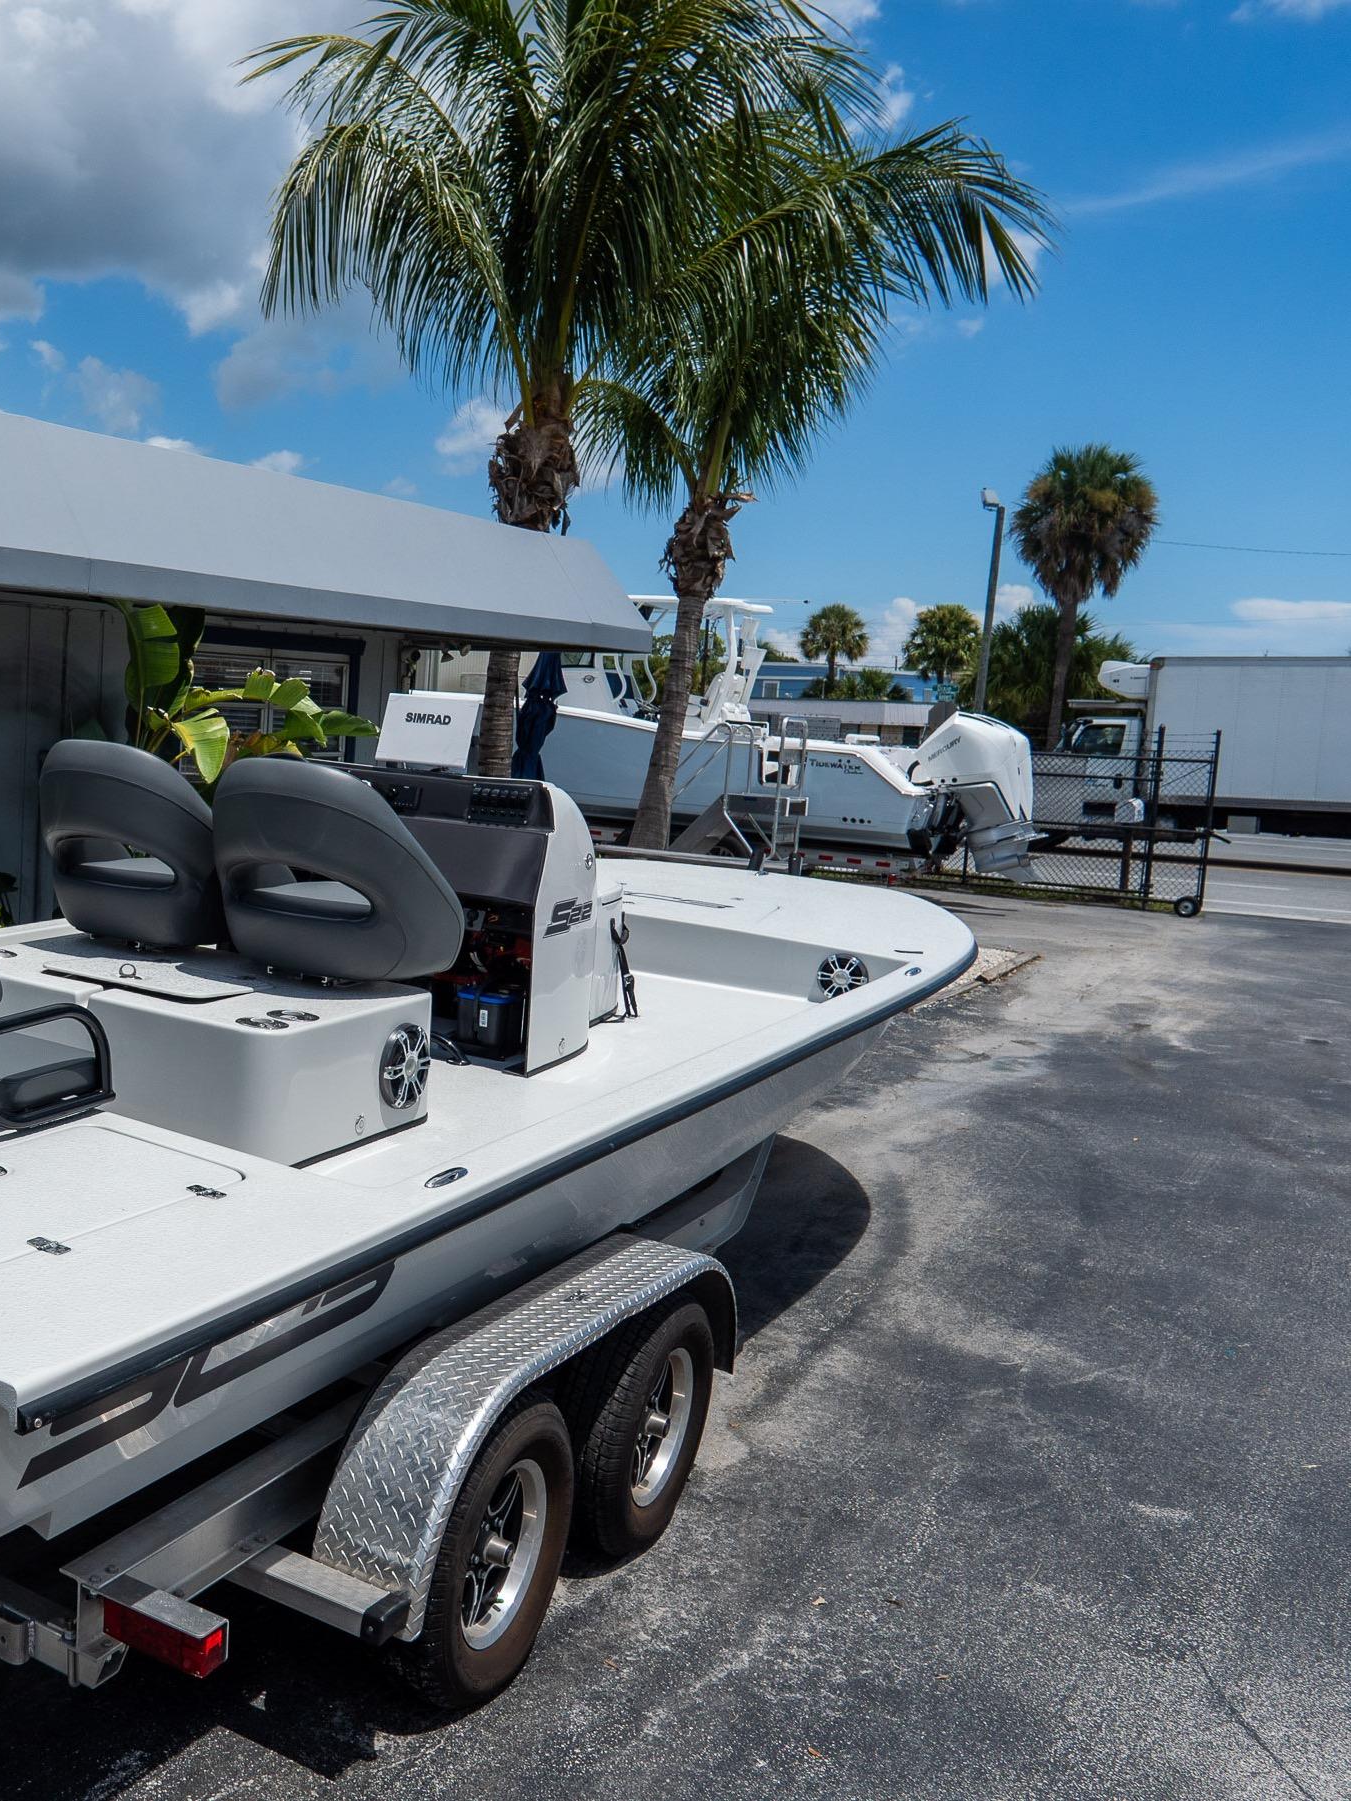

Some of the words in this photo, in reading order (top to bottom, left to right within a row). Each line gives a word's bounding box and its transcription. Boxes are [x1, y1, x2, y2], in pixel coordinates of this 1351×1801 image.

[405, 711, 452, 726] SIMRAD
[928, 736, 962, 762] MERCURY
[542, 896, 593, 939] S22
